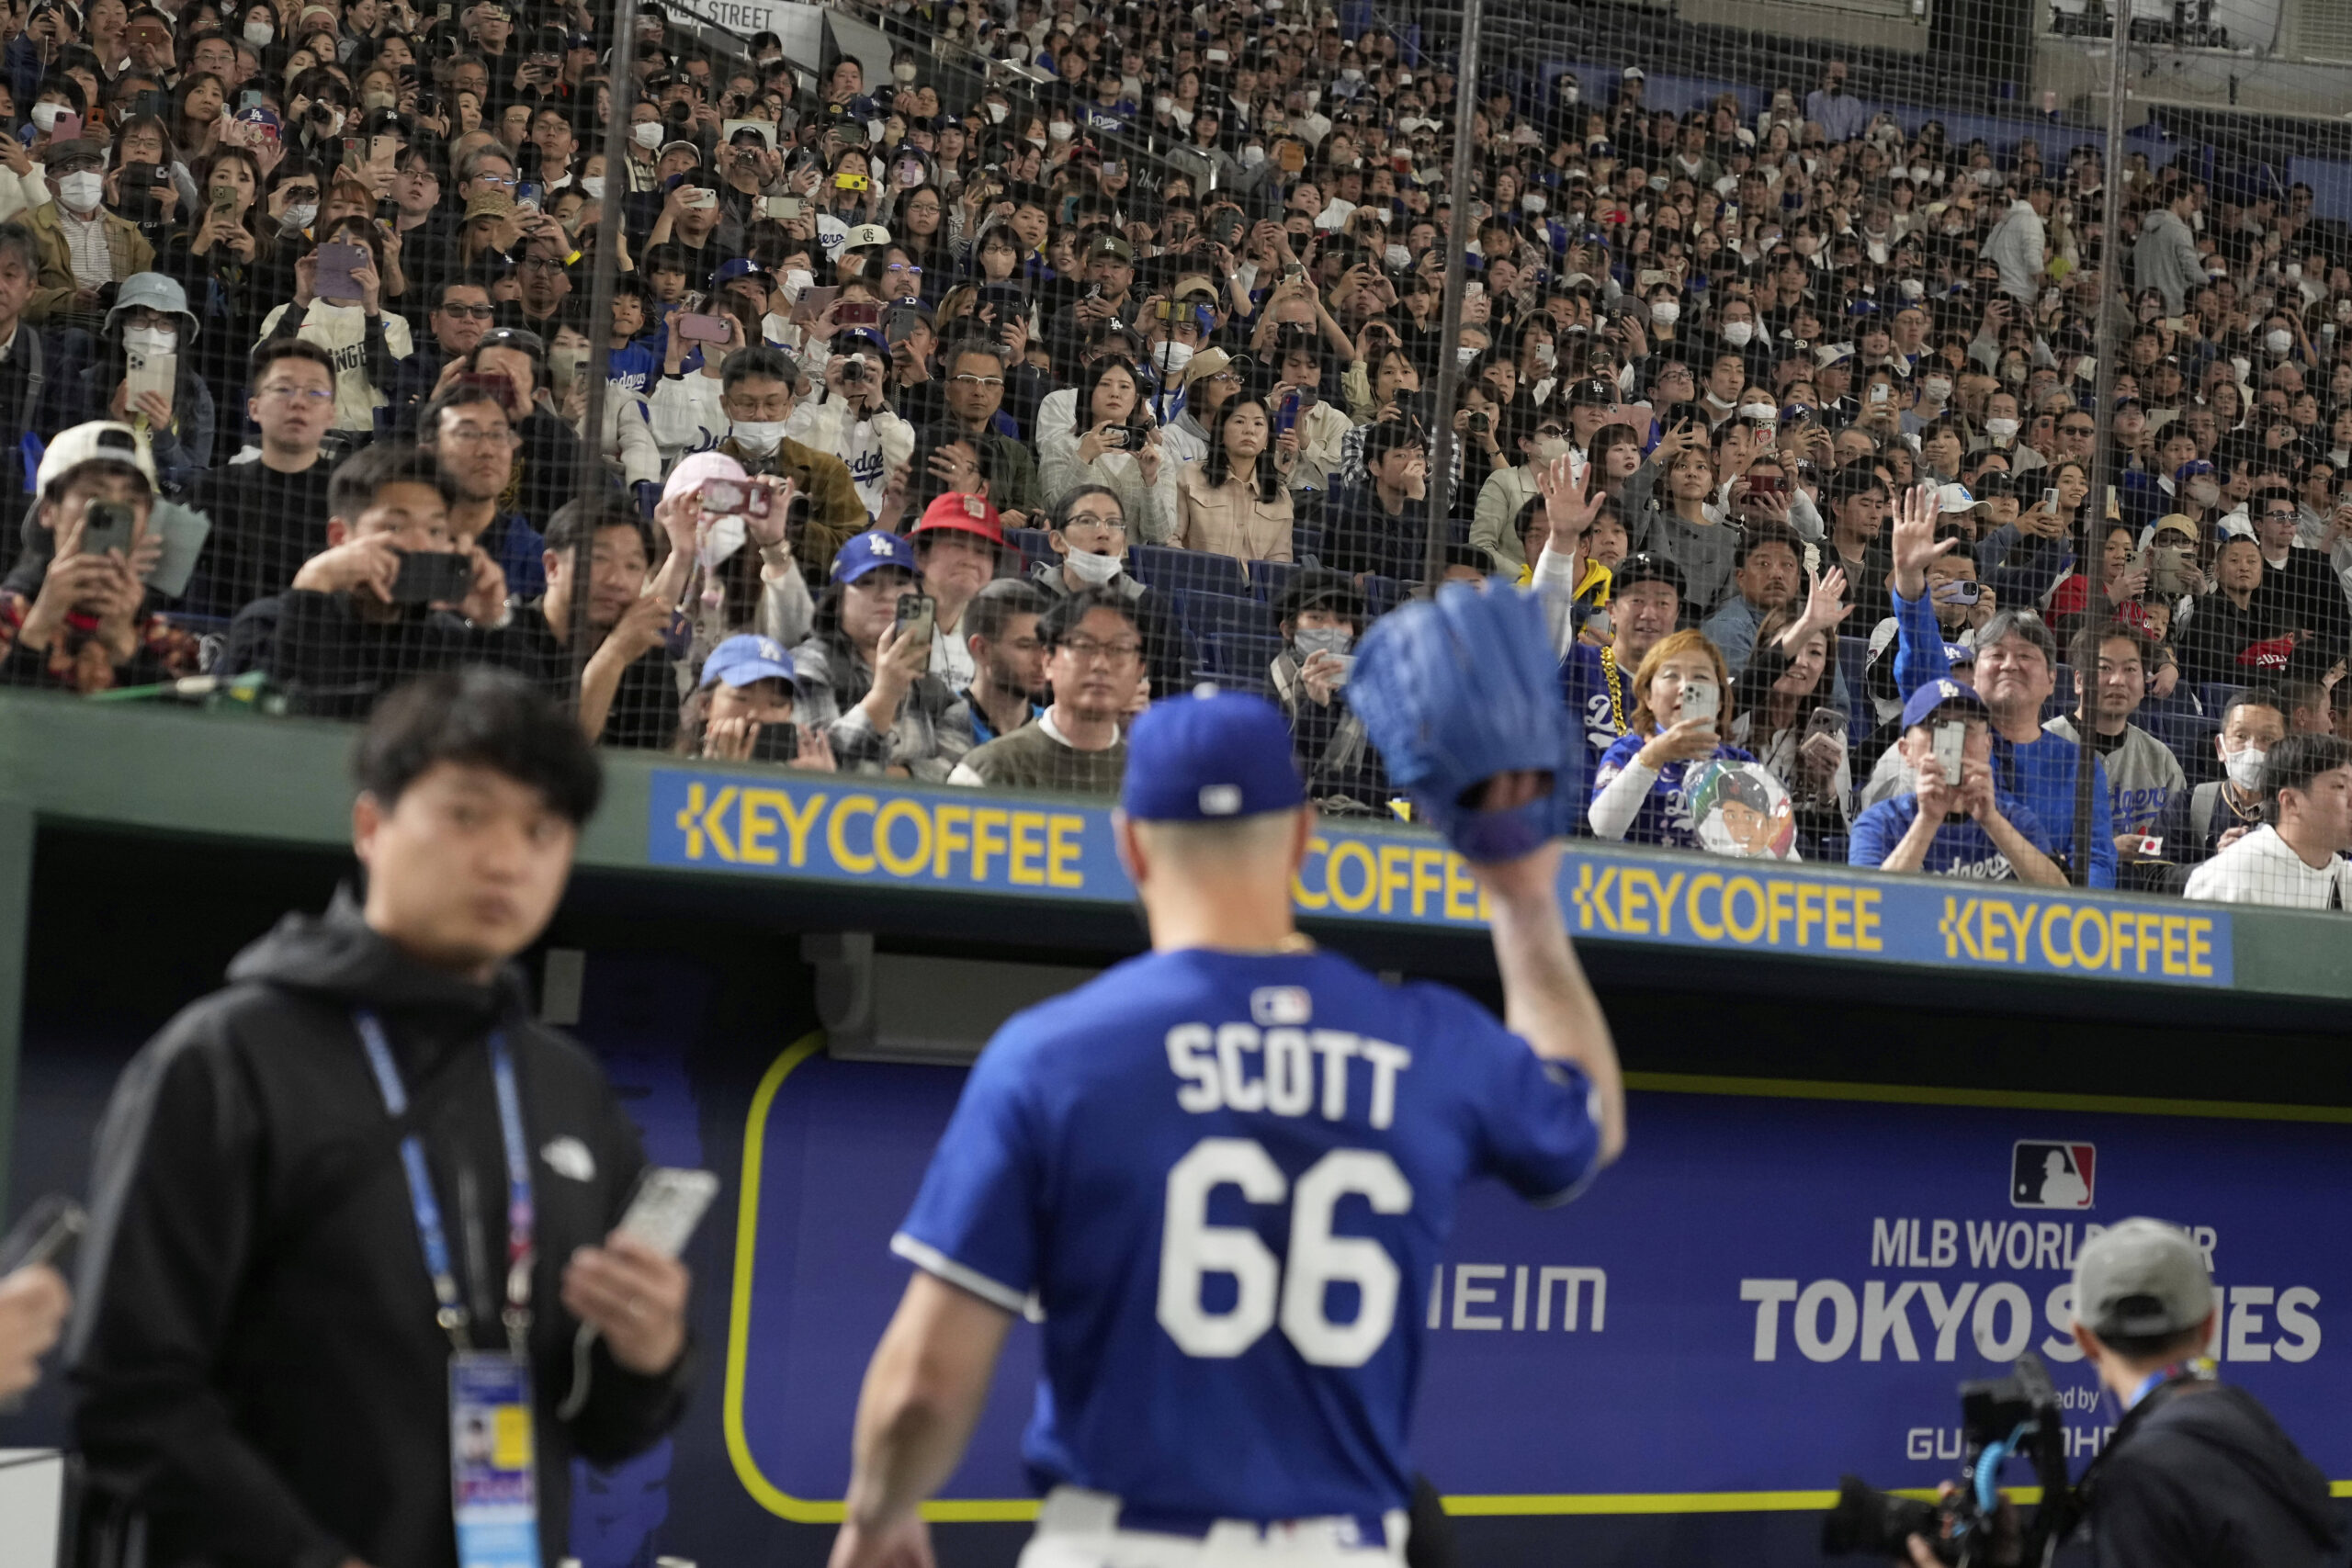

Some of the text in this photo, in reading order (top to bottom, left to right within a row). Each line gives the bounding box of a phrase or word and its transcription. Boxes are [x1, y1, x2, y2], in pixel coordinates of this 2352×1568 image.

[707, 1, 774, 30] STREET
[250, 108, 263, 121] LA
[386, 111, 398, 120] LA
[1104, 238, 1115, 251] LA
[745, 260, 759, 272] LA
[1110, 317, 1124, 330] LA
[1592, 380, 1604, 393] LA
[868, 534, 894, 556] LA
[1943, 646, 1962, 660] LA
[1937, 679, 1960, 698] LA
[1165, 1022, 1412, 1130] SCOTT
[1155, 1136, 1414, 1369] 66
[1871, 1218, 1958, 1268] MLB
[1740, 1279, 2032, 1363] TOKYO
[2078, 1386, 2099, 1414] by
